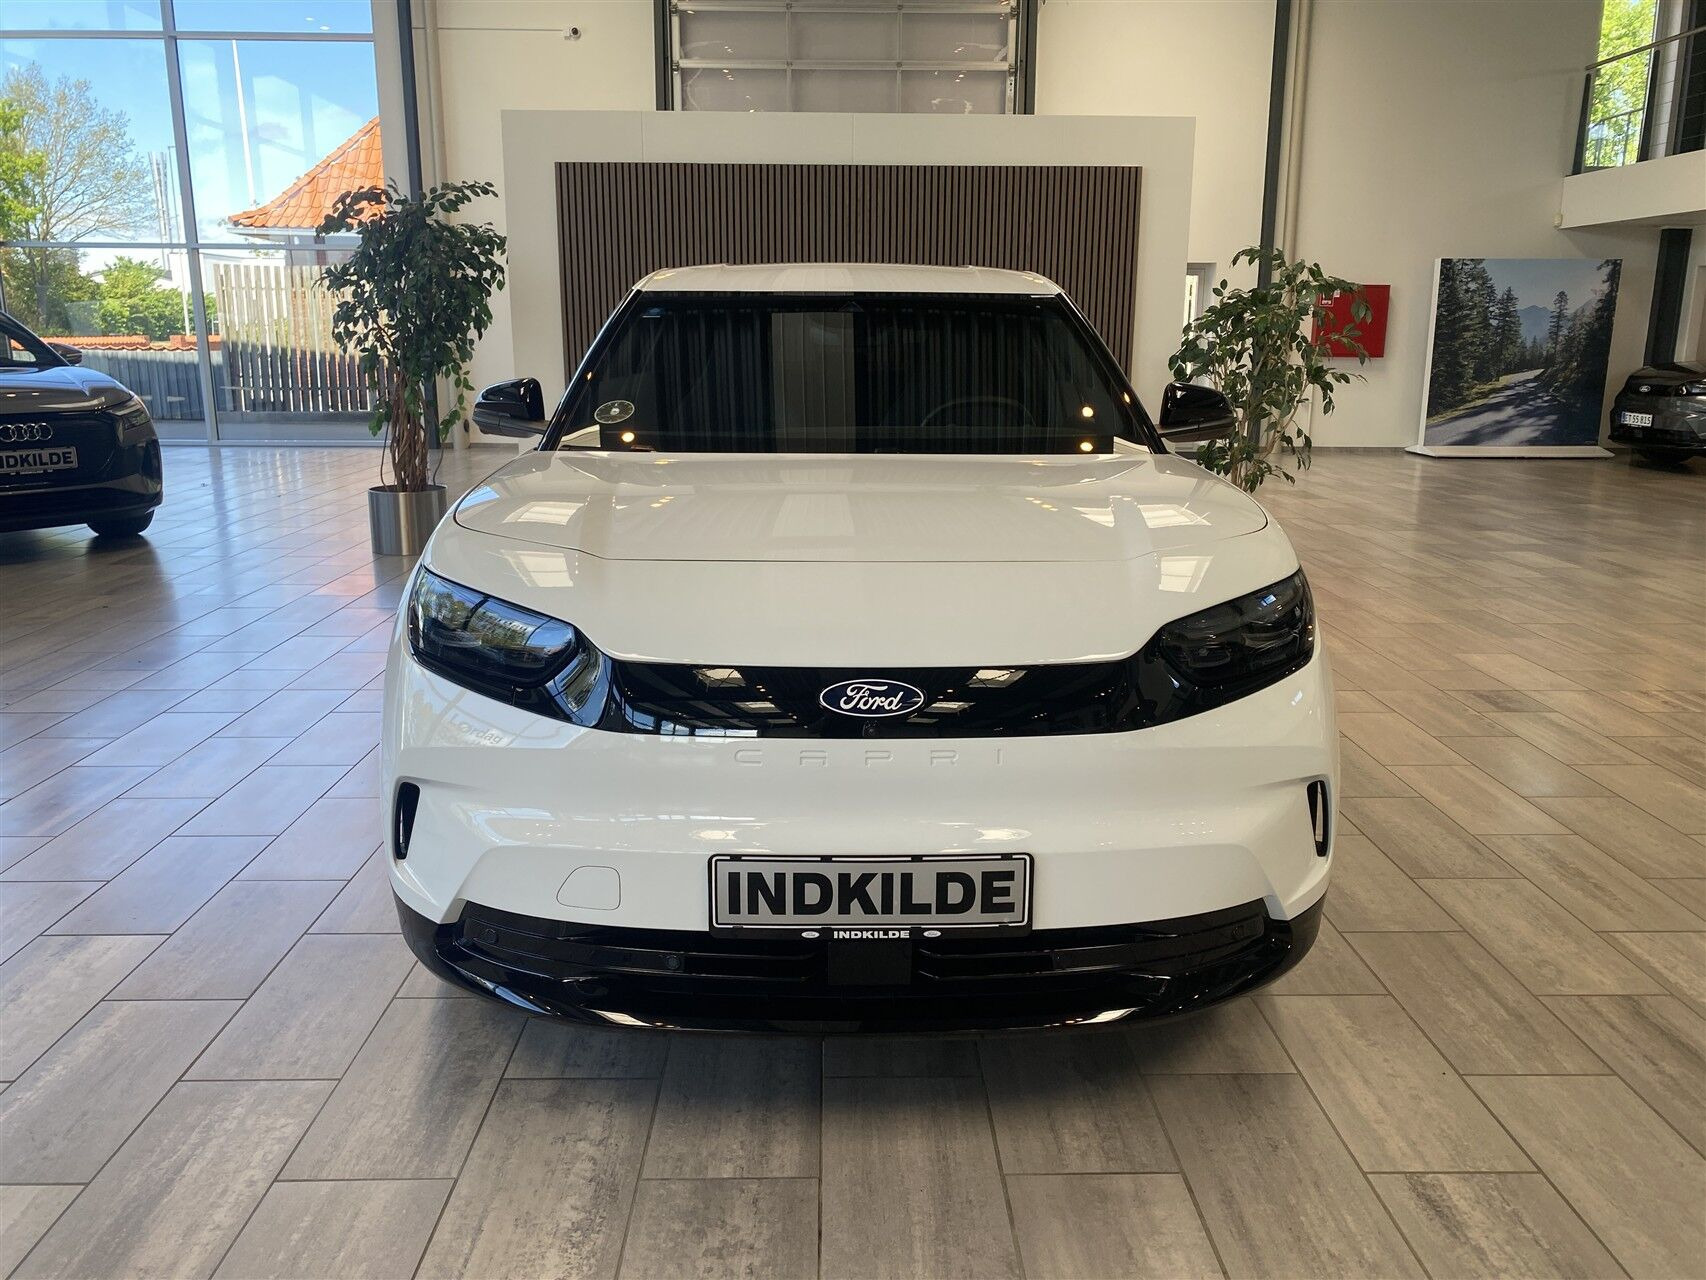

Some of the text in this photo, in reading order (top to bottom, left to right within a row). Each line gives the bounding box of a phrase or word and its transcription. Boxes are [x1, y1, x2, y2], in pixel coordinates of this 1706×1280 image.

[1632, 415, 1639, 423] 55
[840, 684, 904, 710] Ford
[735, 748, 1003, 768] CAPRI
[728, 871, 1015, 916] INDKILDE
[833, 930, 910, 939] INDKILDE
